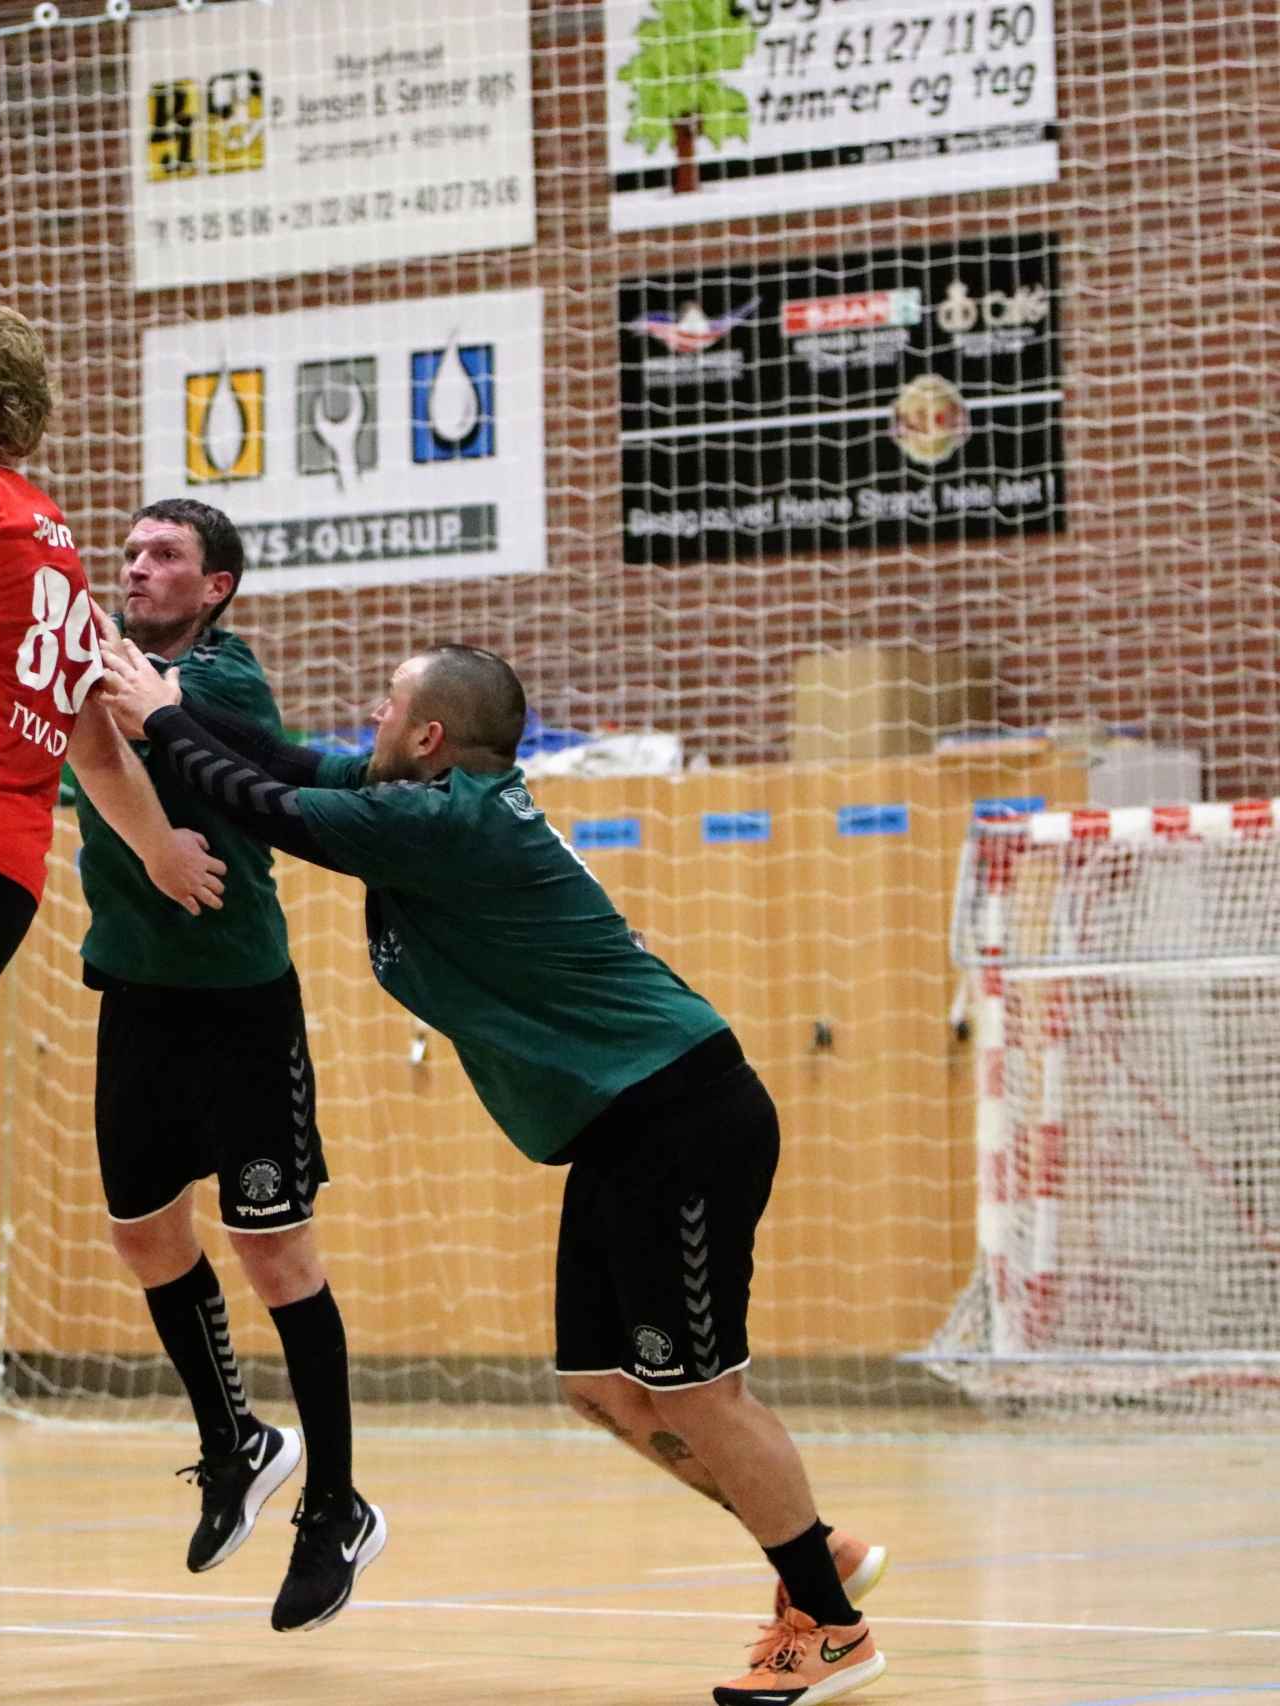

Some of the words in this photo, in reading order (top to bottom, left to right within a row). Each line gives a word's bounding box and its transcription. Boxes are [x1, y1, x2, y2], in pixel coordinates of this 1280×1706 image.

[833, 23, 874, 71] 61
[885, 17, 933, 61] 27
[943, 9, 977, 56] 11
[987, 4, 1036, 51] 50
[908, 73, 952, 117] og
[971, 61, 1037, 107] tag
[32, 512, 75, 550] SPOR
[15, 565, 104, 716] 89
[249, 1200, 291, 1217] hummel
